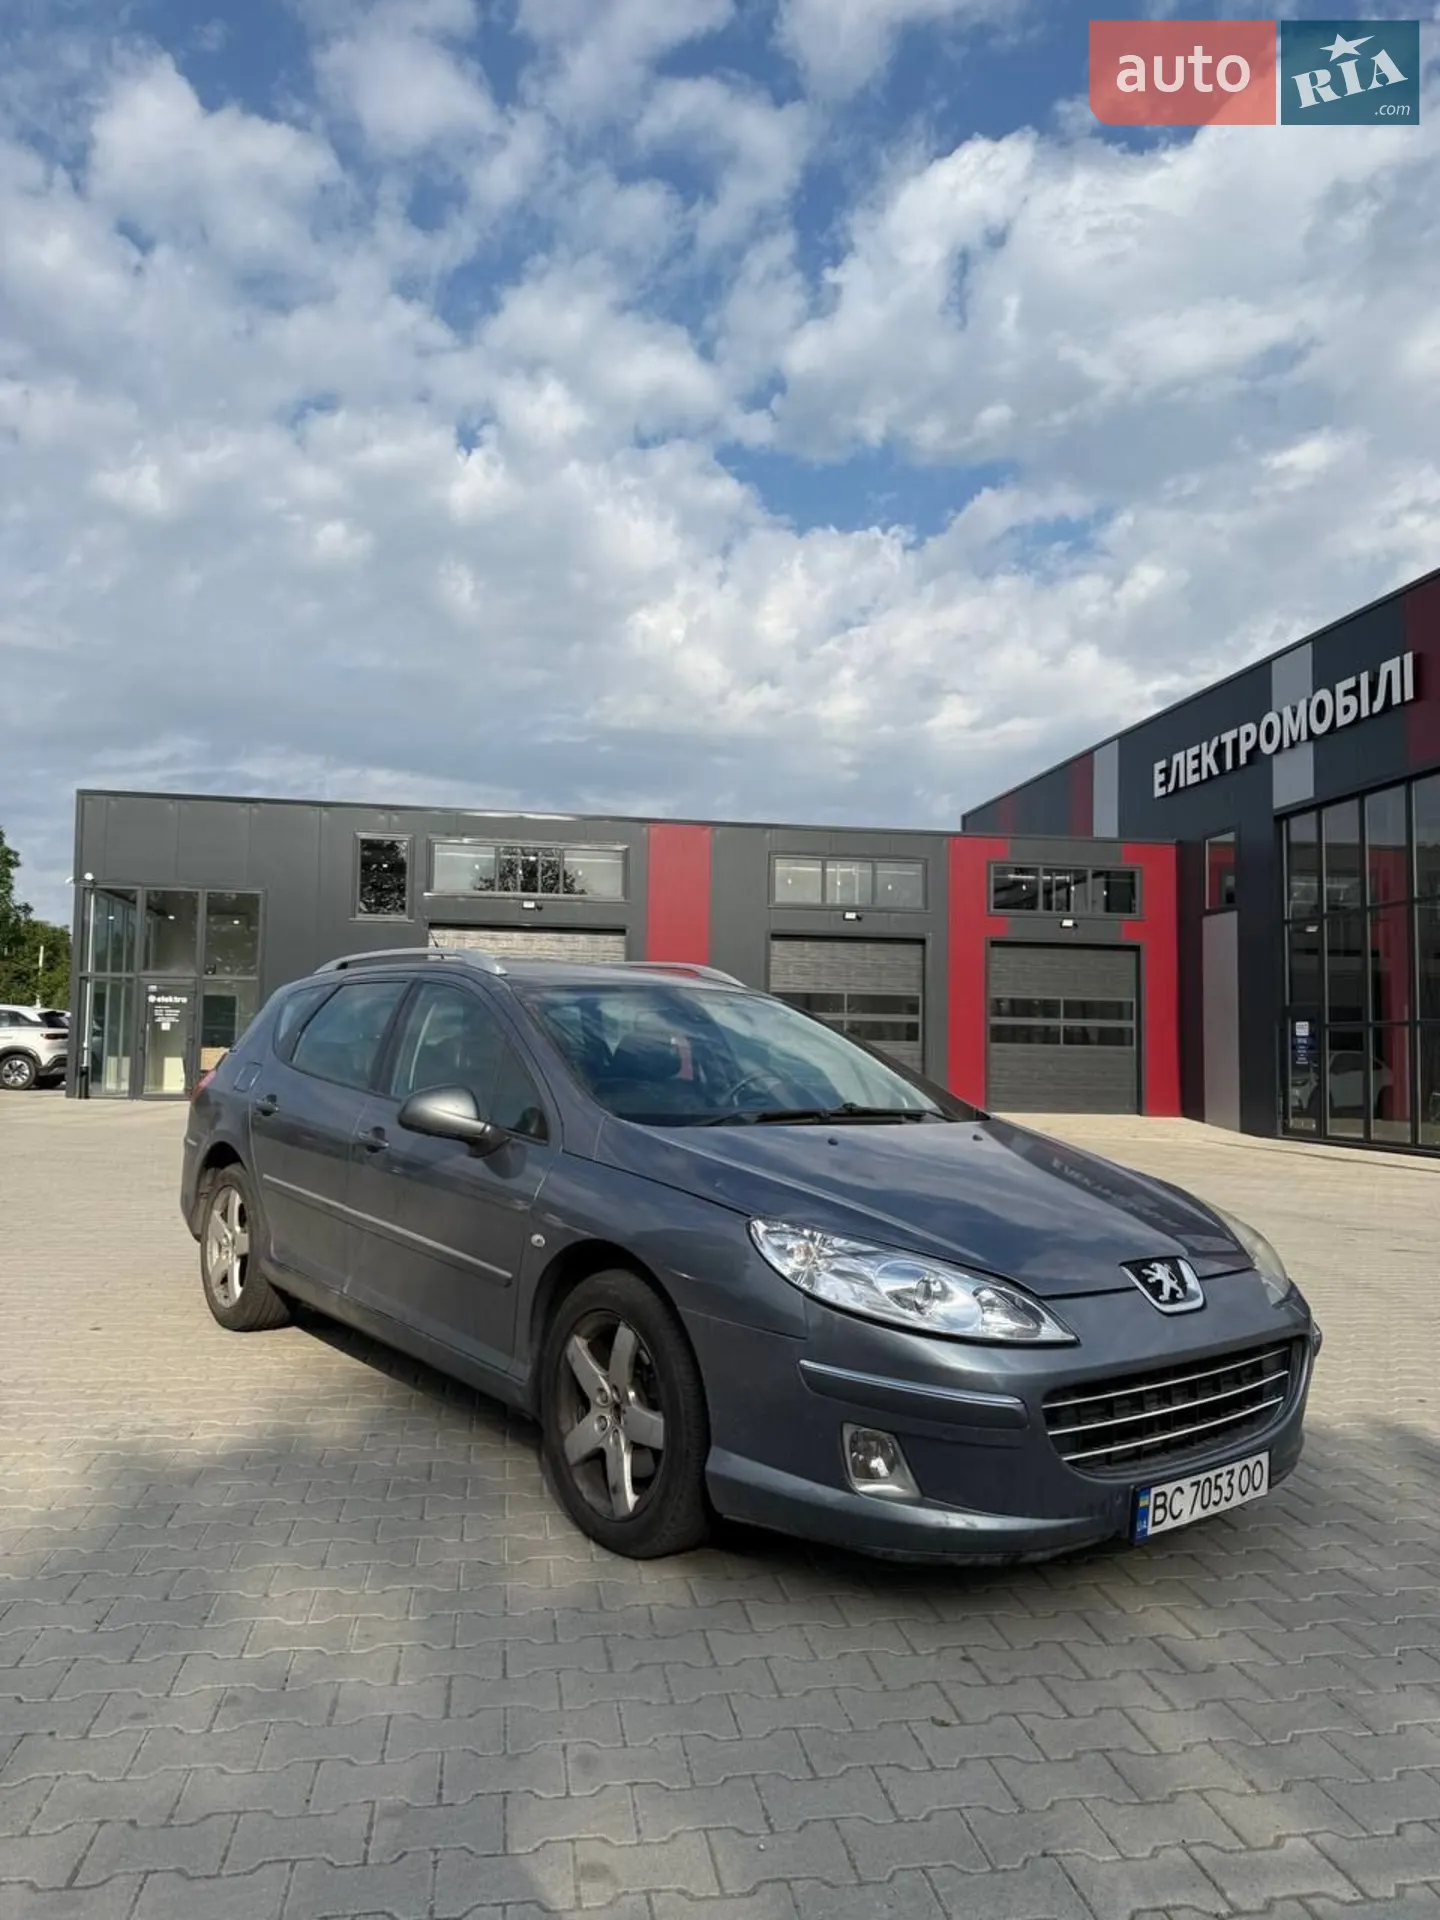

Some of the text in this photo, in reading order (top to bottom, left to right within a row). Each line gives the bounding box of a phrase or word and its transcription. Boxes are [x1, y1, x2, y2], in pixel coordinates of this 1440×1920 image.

[1153, 651, 1414, 799] ЕЛЕКТРОМОБІЛІ
[1151, 1460, 1264, 1527] BC 7053 OO
